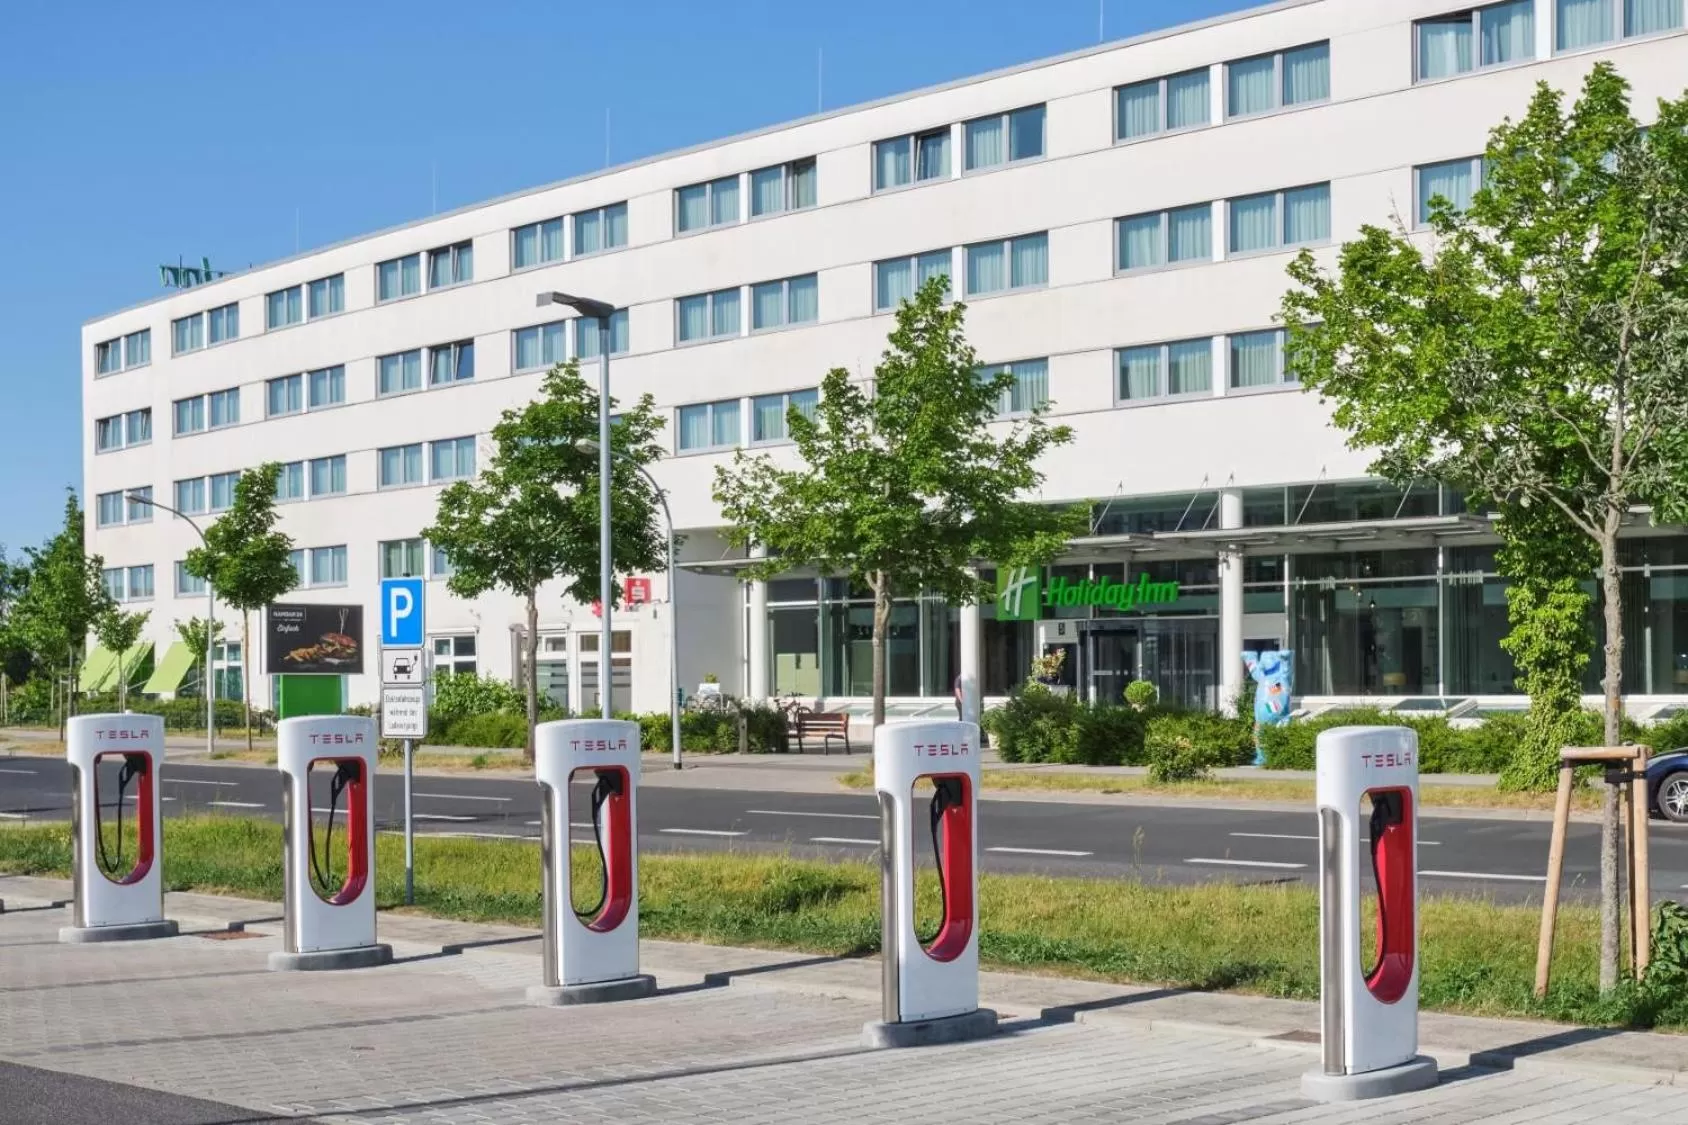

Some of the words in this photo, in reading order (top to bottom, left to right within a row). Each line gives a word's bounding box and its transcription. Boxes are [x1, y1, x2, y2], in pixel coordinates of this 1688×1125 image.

[1048, 575, 1136, 611] Holiday
[1137, 572, 1179, 604] Inn
[391, 587, 413, 637] P
[95, 730, 149, 739] TESLA
[309, 733, 364, 744] TESLA
[570, 739, 627, 751] TESLA
[913, 743, 969, 756] TESLA
[1361, 752, 1411, 768] TESLA
